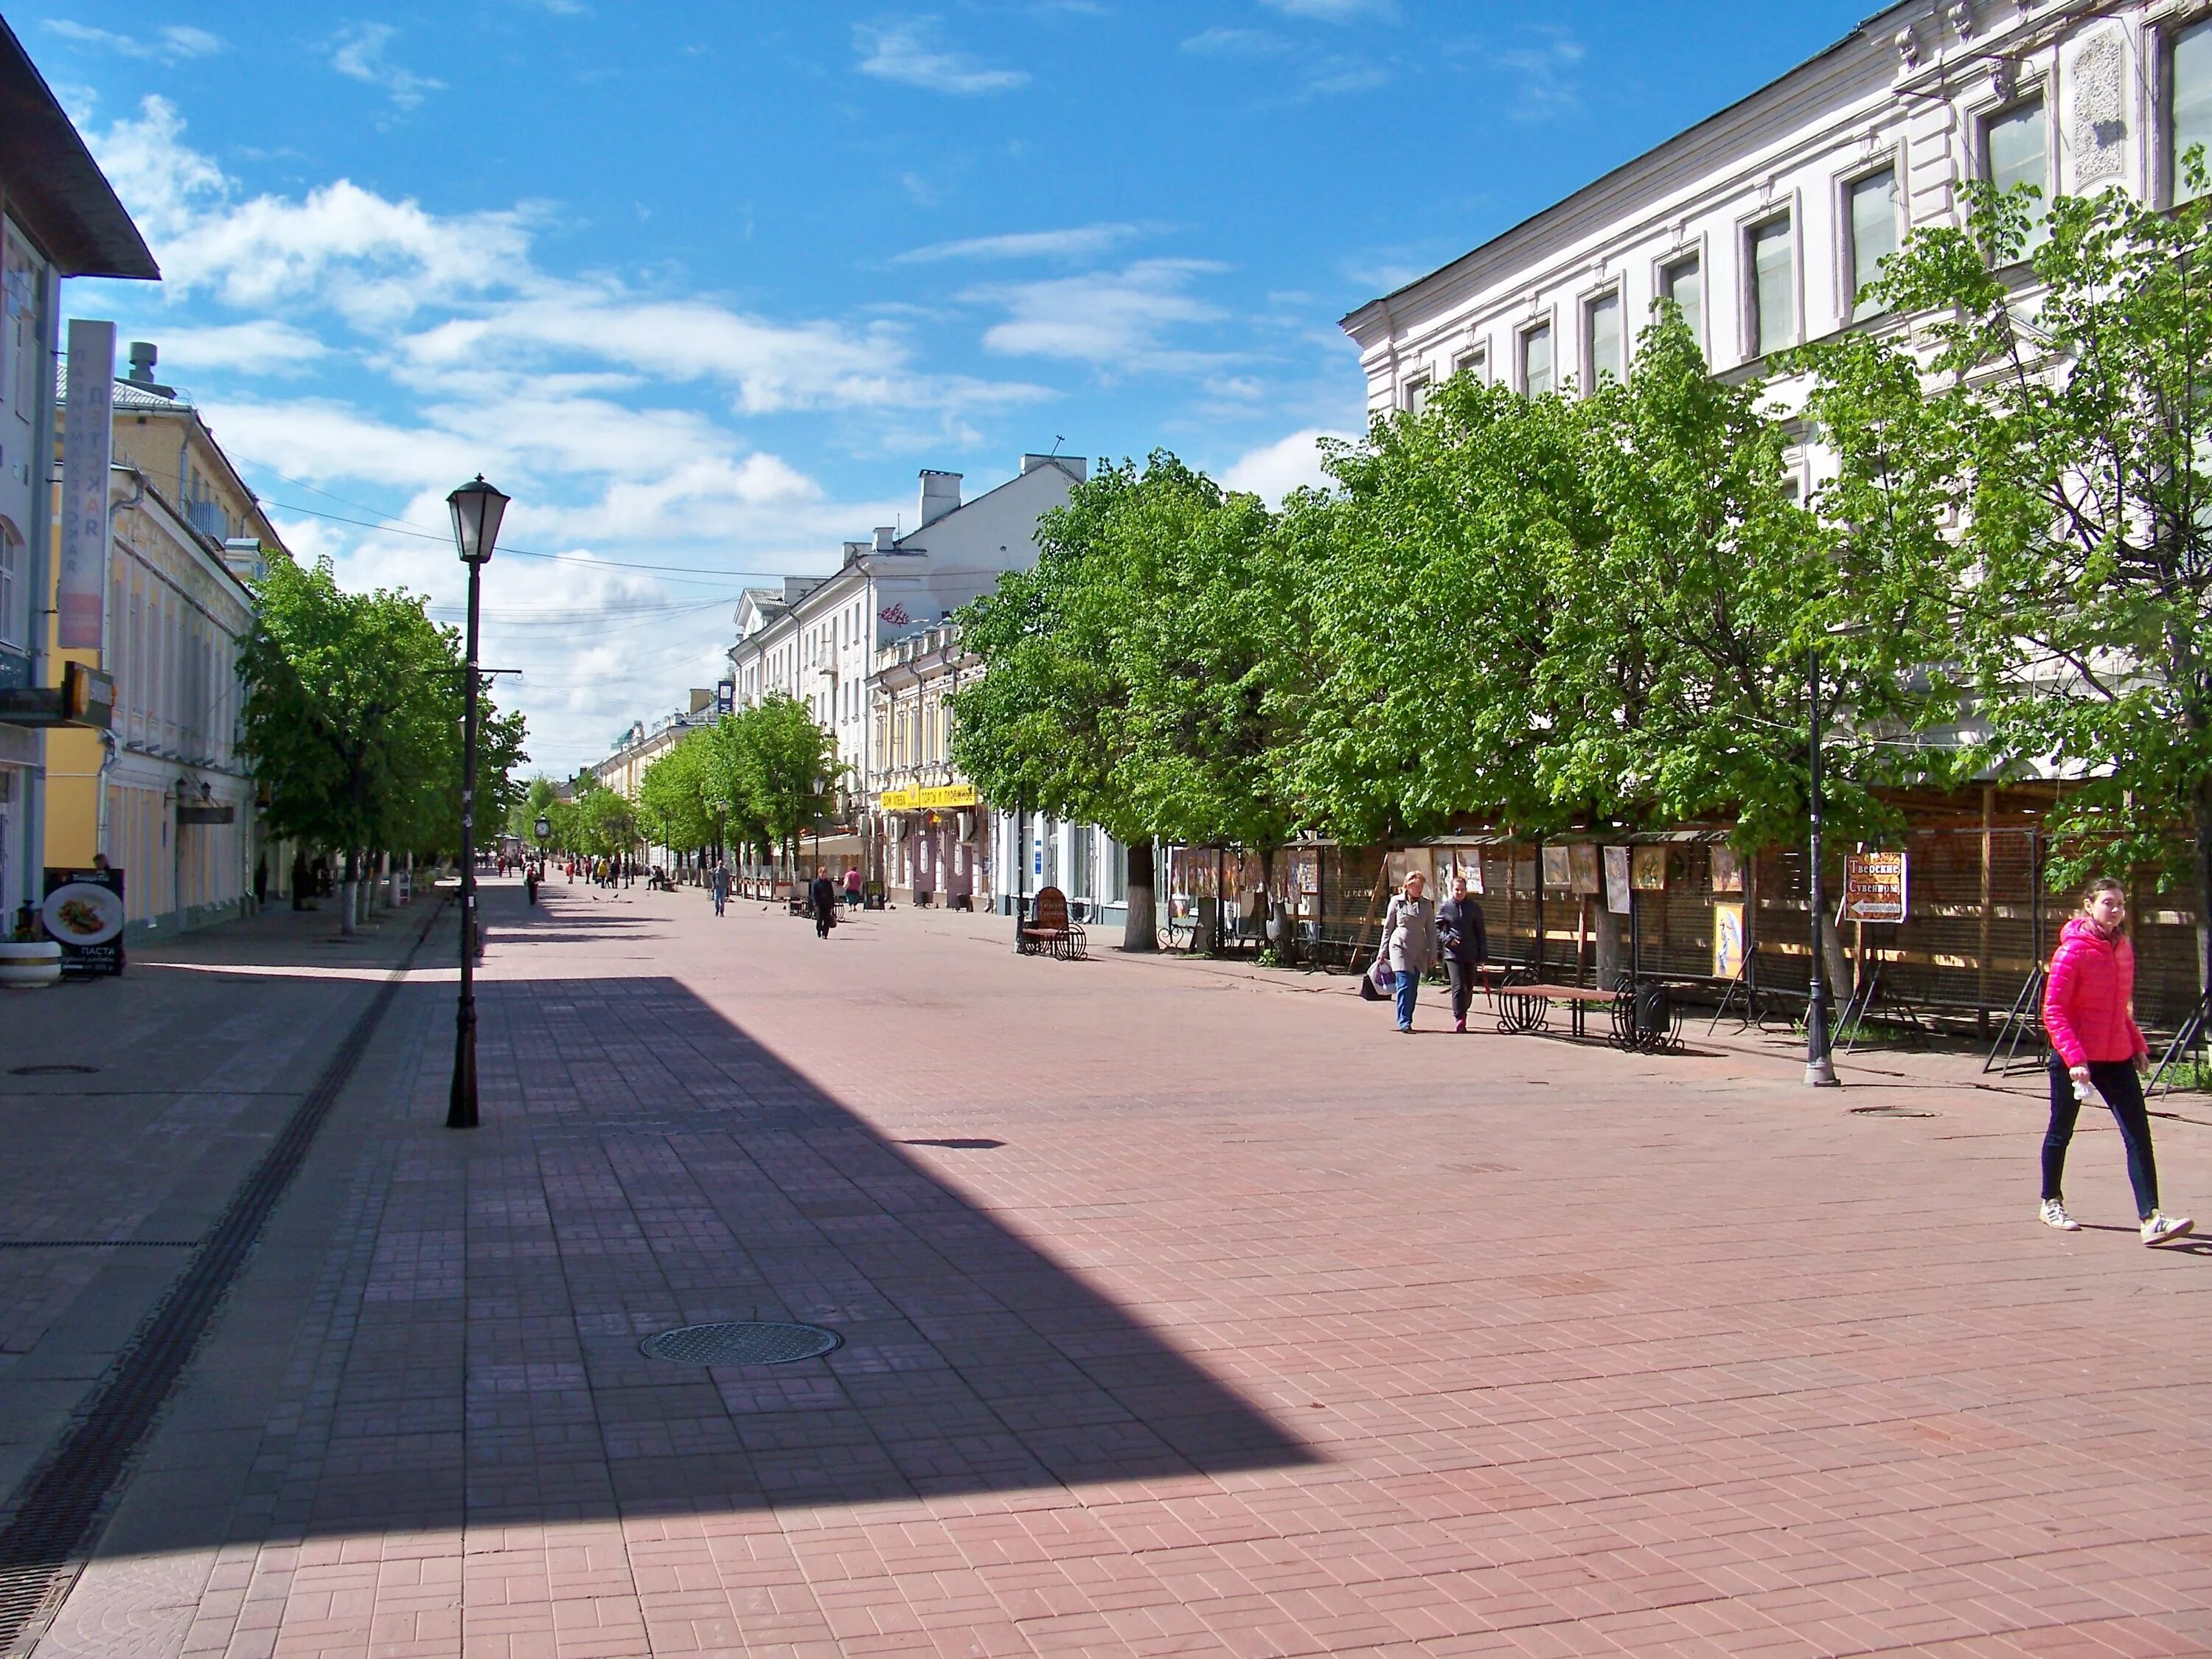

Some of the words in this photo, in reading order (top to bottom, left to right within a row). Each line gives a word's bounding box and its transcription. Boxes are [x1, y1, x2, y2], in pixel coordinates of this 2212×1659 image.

[1850, 860, 1899, 876] Тверские
[1850, 880, 1899, 894] Сувениры
[82, 947, 115, 956] ПАСТА
